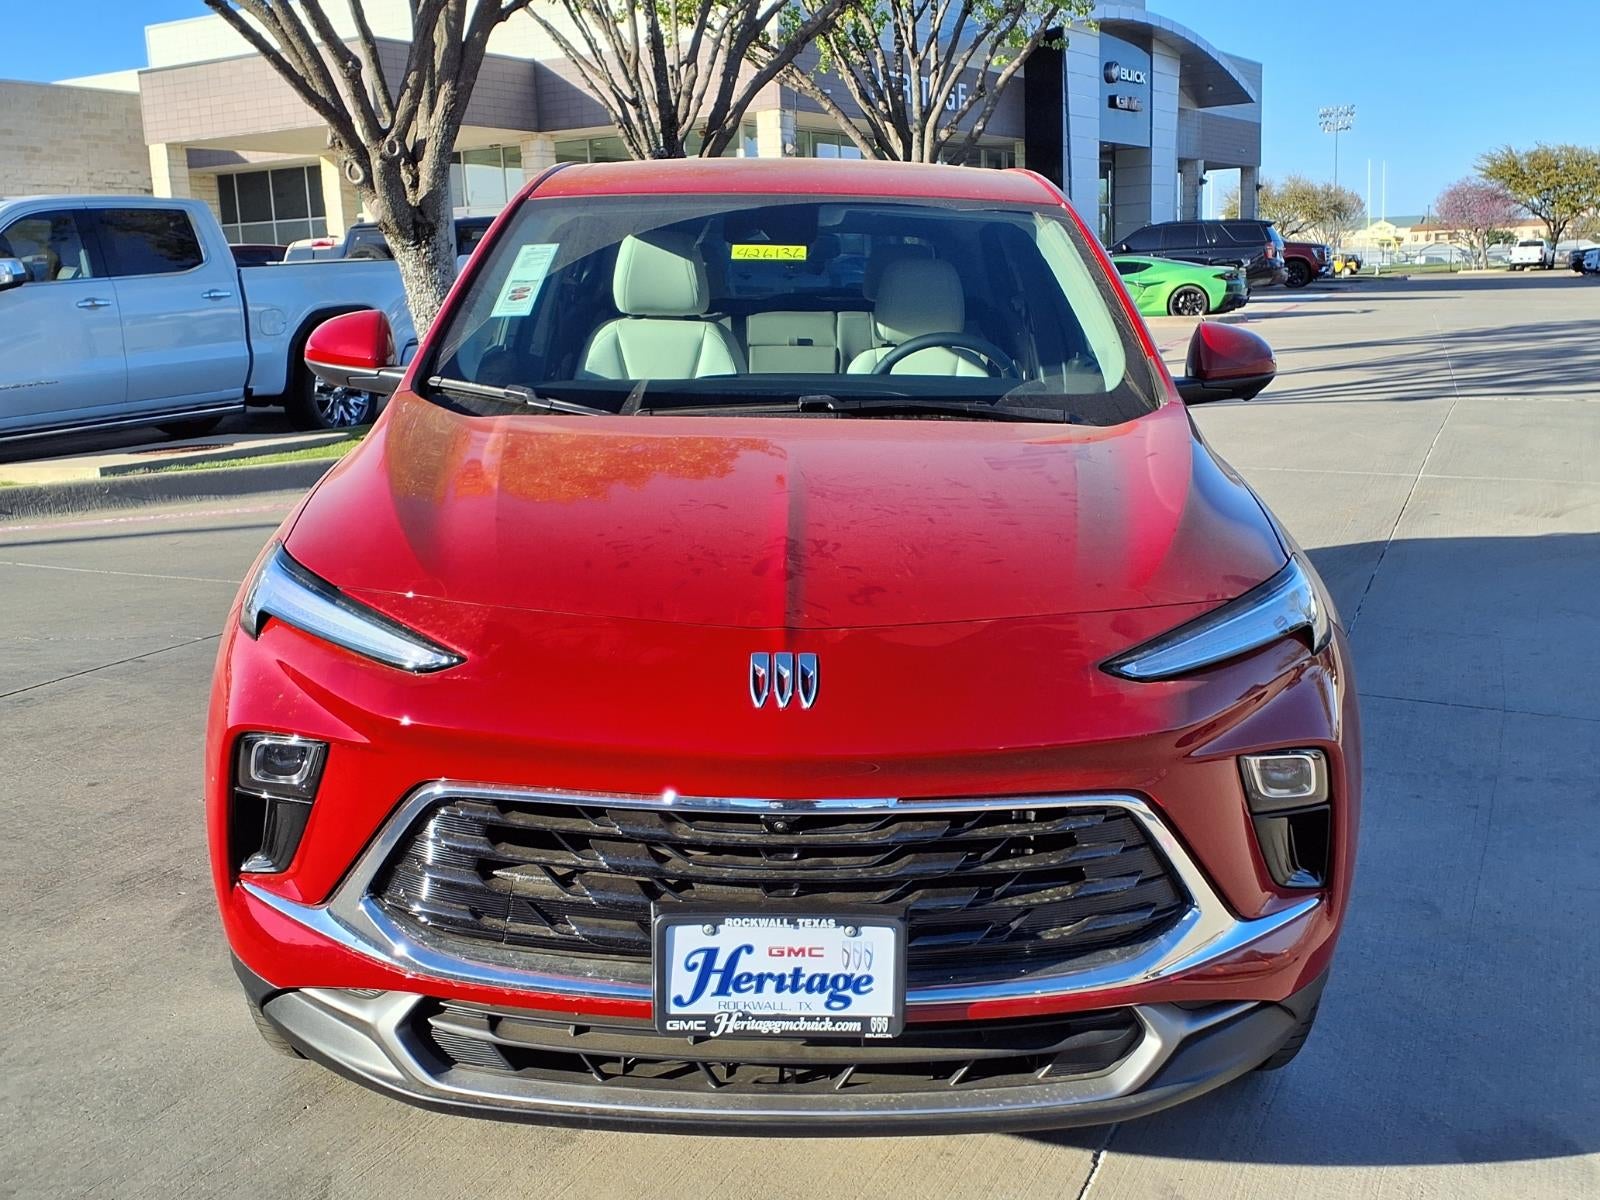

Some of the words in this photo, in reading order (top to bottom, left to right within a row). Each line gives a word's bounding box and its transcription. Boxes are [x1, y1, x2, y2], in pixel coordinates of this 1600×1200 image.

[1120, 67, 1146, 84] BUICK
[736, 247, 805, 258] 426136
[725, 918, 794, 929] ROCKWALL,
[798, 918, 836, 929] TEXAS
[768, 946, 825, 958] GMC
[672, 944, 874, 1011] Heritage
[798, 1001, 814, 1011] TX
[666, 1020, 707, 1031] GMC
[710, 1012, 862, 1037] Heritagegmcbuick.com
